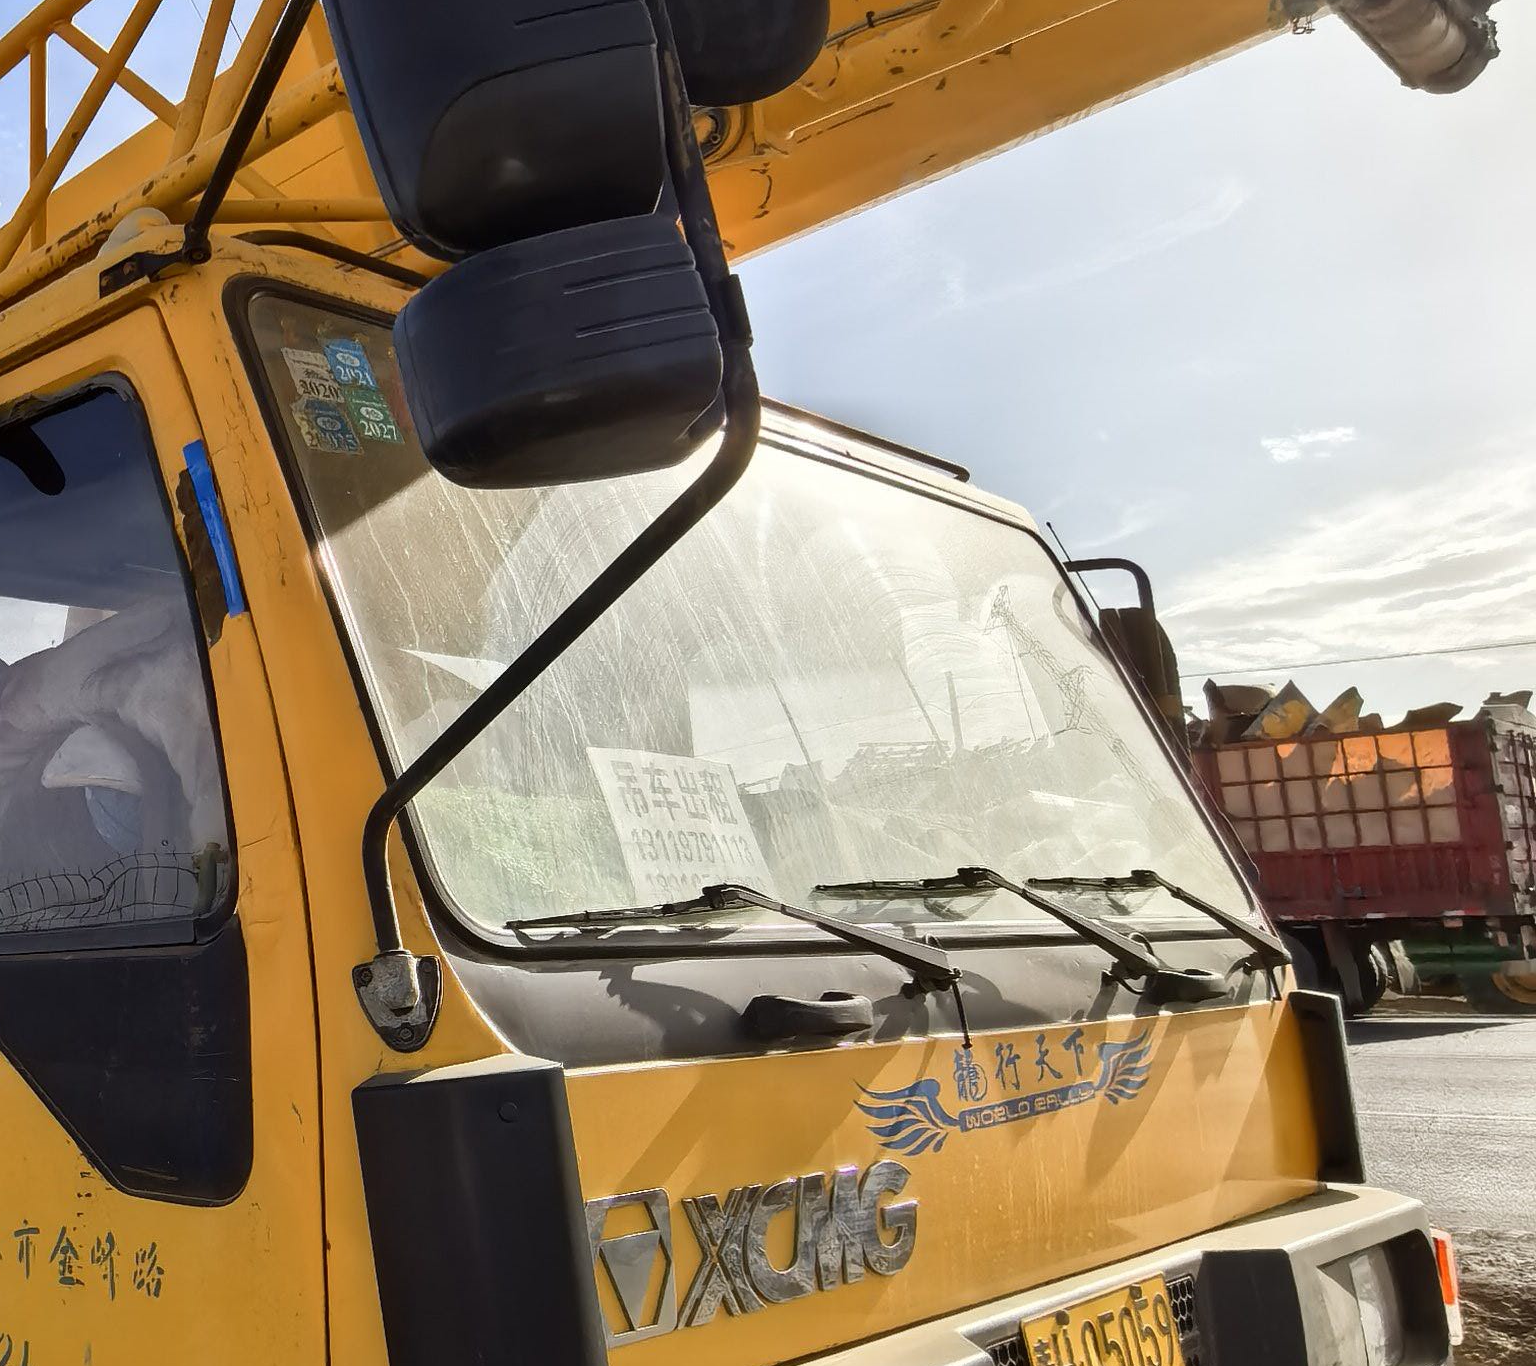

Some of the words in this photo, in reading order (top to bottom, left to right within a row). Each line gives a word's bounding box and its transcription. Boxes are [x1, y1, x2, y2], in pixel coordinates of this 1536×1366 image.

[610, 760, 738, 825] 吊车出租
[677, 1159, 919, 1331] XCMG
